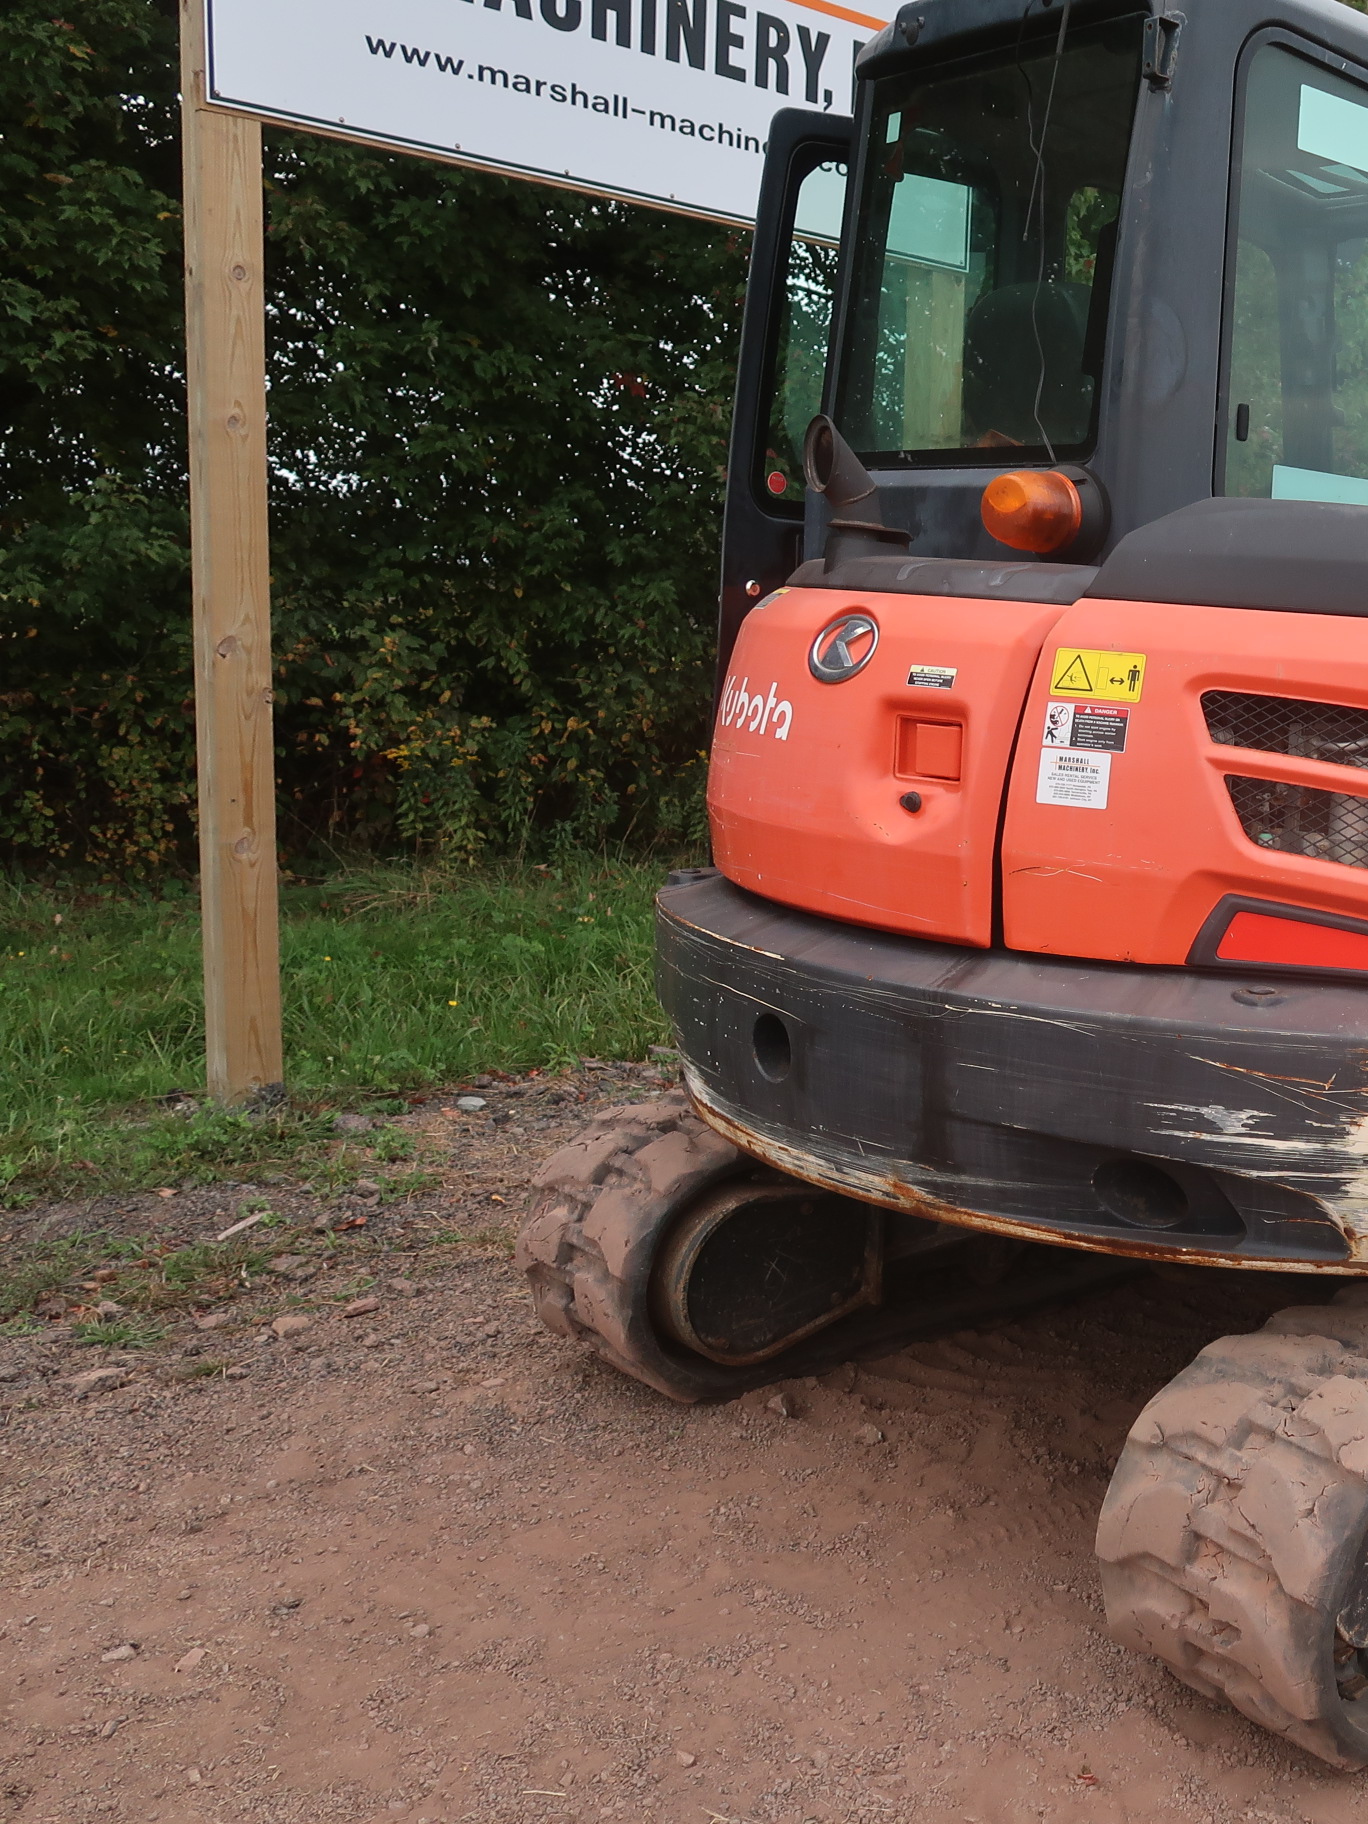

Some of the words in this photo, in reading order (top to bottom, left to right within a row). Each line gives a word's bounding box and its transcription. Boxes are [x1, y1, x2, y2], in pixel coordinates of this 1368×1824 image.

[461, 0, 833, 112] HINERY,
[720, 675, 793, 741] Kubota
[1058, 756, 1090, 765] MARSHALL
